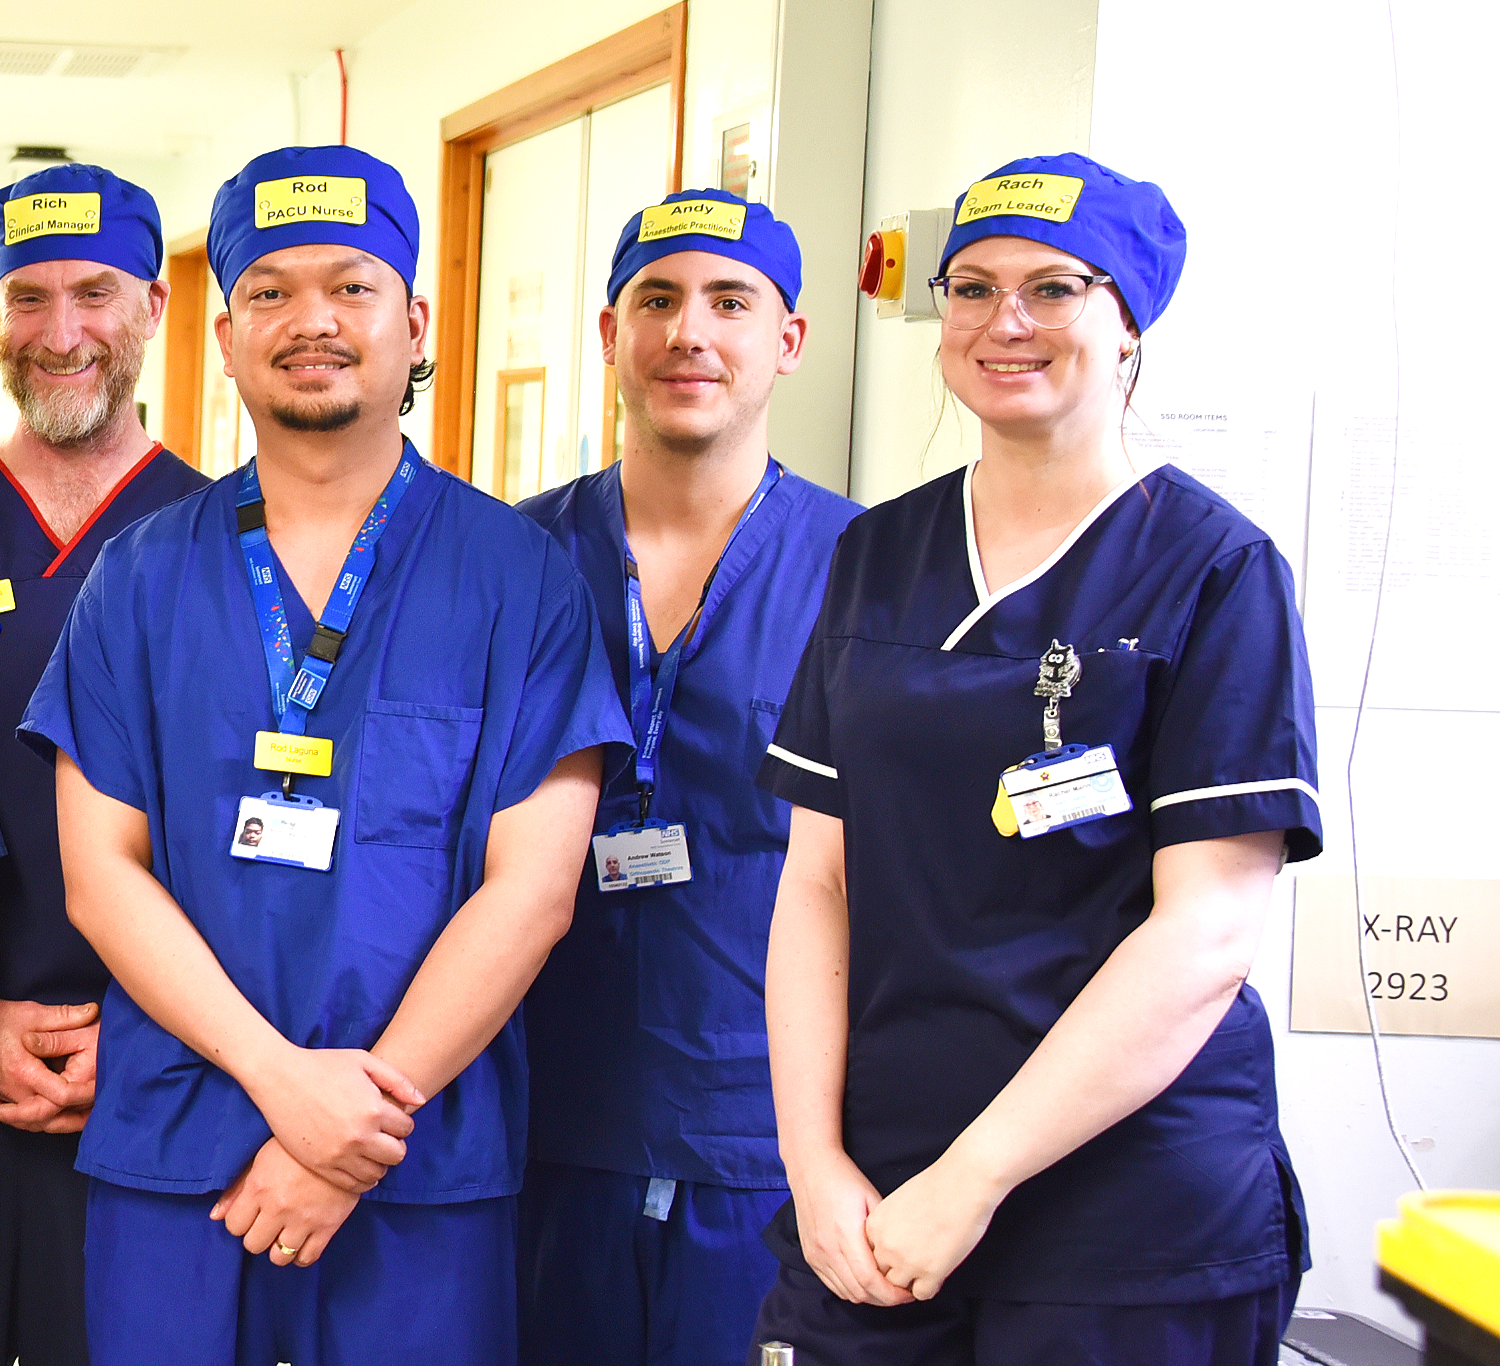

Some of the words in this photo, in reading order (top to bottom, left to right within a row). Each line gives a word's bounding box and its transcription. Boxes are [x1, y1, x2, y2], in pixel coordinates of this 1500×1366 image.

[292, 182, 327, 194] Rod
[996, 178, 1044, 192] Rach
[32, 198, 67, 210] Rich
[670, 204, 714, 216] Andy
[967, 202, 1002, 217] Team
[1006, 200, 1061, 214] Leader
[268, 206, 306, 222] PACU
[312, 206, 354, 218] Nurse
[8, 221, 44, 240] Clinical
[47, 220, 95, 231] Manager
[642, 222, 688, 238] Anaesthetic
[690, 222, 736, 234] Practitioner
[262, 566, 272, 584] NHS
[339, 572, 354, 590] NHS
[270, 742, 287, 752] Rod
[289, 745, 318, 756] Laguna
[661, 828, 680, 838] NHS
[1363, 914, 1458, 944] X-RAY
[1367, 971, 1449, 1001] 2923
